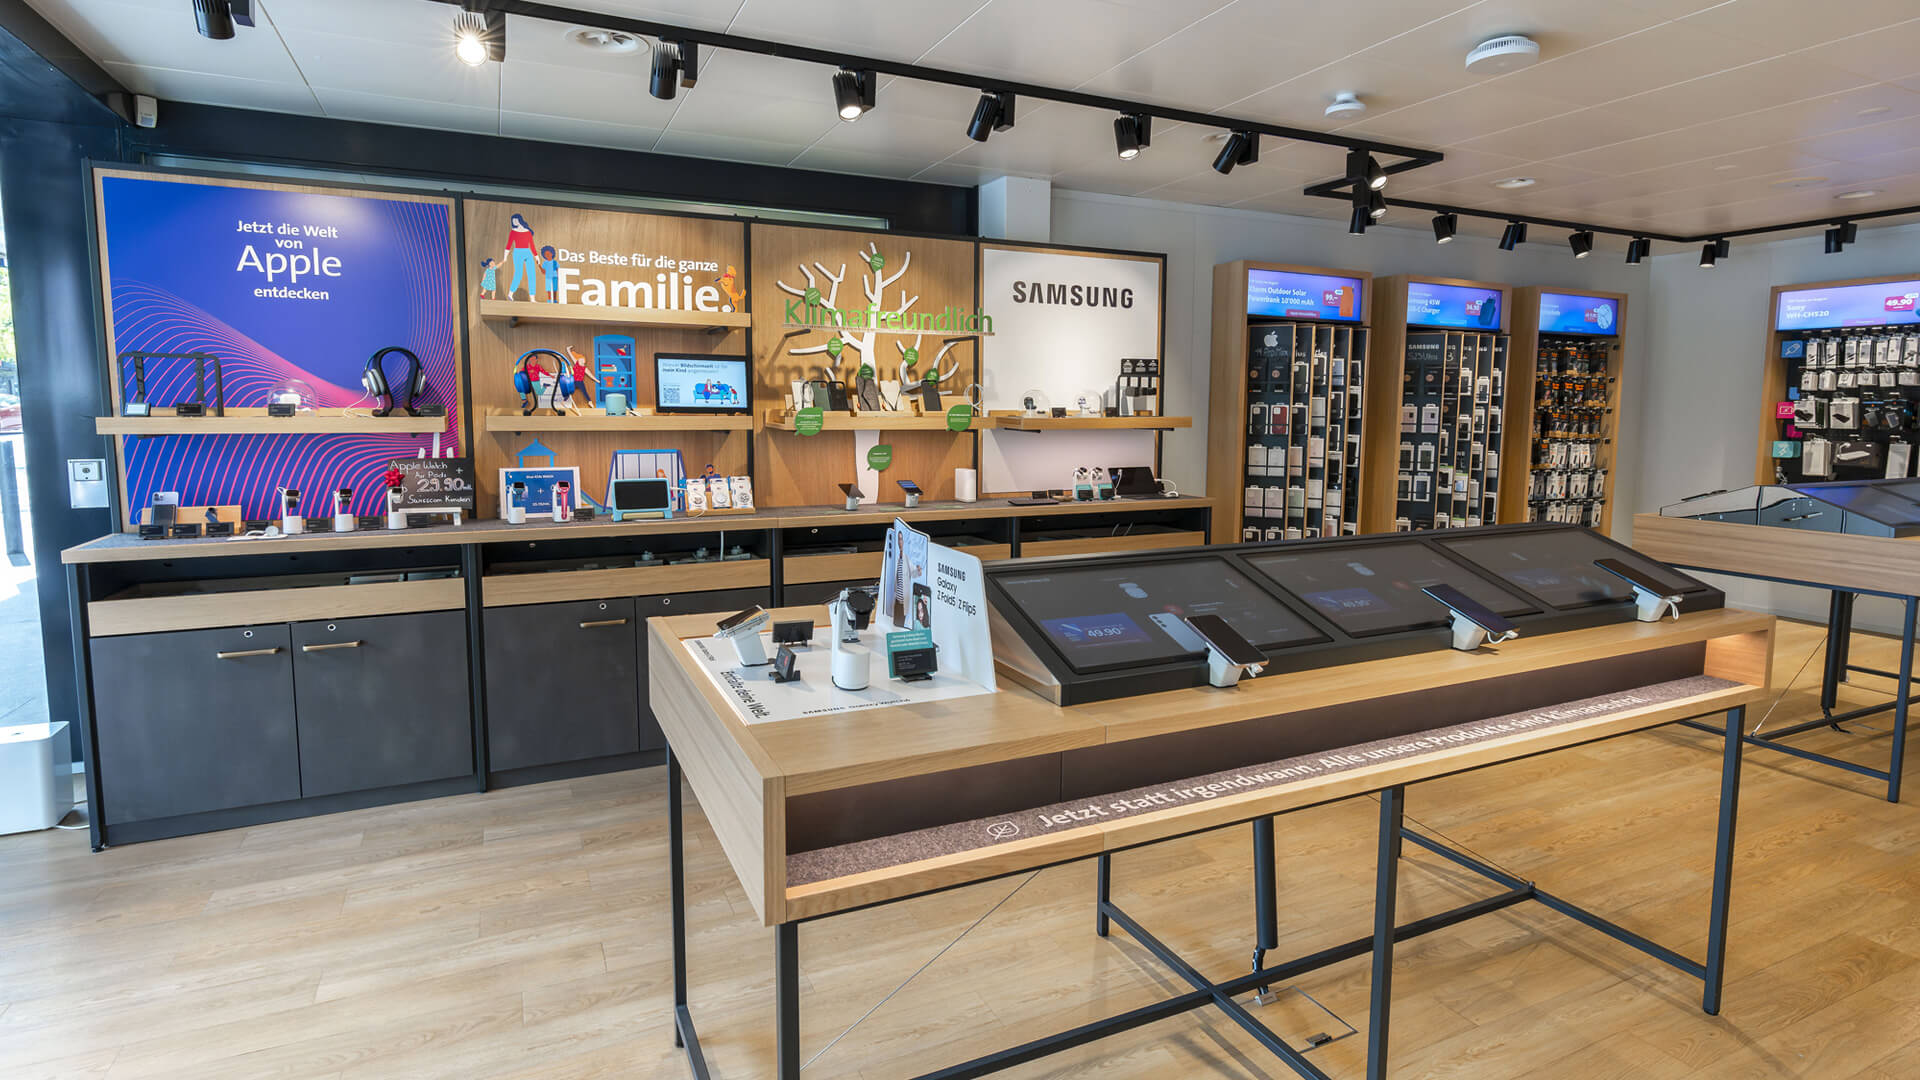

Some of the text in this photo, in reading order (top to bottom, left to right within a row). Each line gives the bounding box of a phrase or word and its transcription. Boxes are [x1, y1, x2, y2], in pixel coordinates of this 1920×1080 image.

[236, 220, 338, 238] Jetzt die Welt
[274, 238, 303, 249] von
[236, 245, 342, 283] Apple
[558, 248, 719, 273] Das Beste für die ganze
[253, 286, 330, 300] entdecken
[558, 268, 732, 313] Familie.
[1012, 281, 1134, 309] SAMSUNG
[1267, 287, 1292, 296] Outdoor
[1886, 298, 1913, 306] 49.90
[784, 298, 993, 334] Klimafreundlich
[389, 460, 420, 474] Apple
[423, 461, 448, 469] Watch
[416, 478, 465, 493] 29.90
[937, 562, 966, 581] SAMSUNG
[937, 576, 957, 595] Galaxy
[1038, 804, 1109, 828] Jetzt
[1110, 792, 1176, 813] statt
[1170, 764, 1322, 799] irgendwann.
[1319, 754, 1368, 770] Alle
[1364, 740, 1433, 759] unsere
[1427, 723, 1516, 747] Produkte
